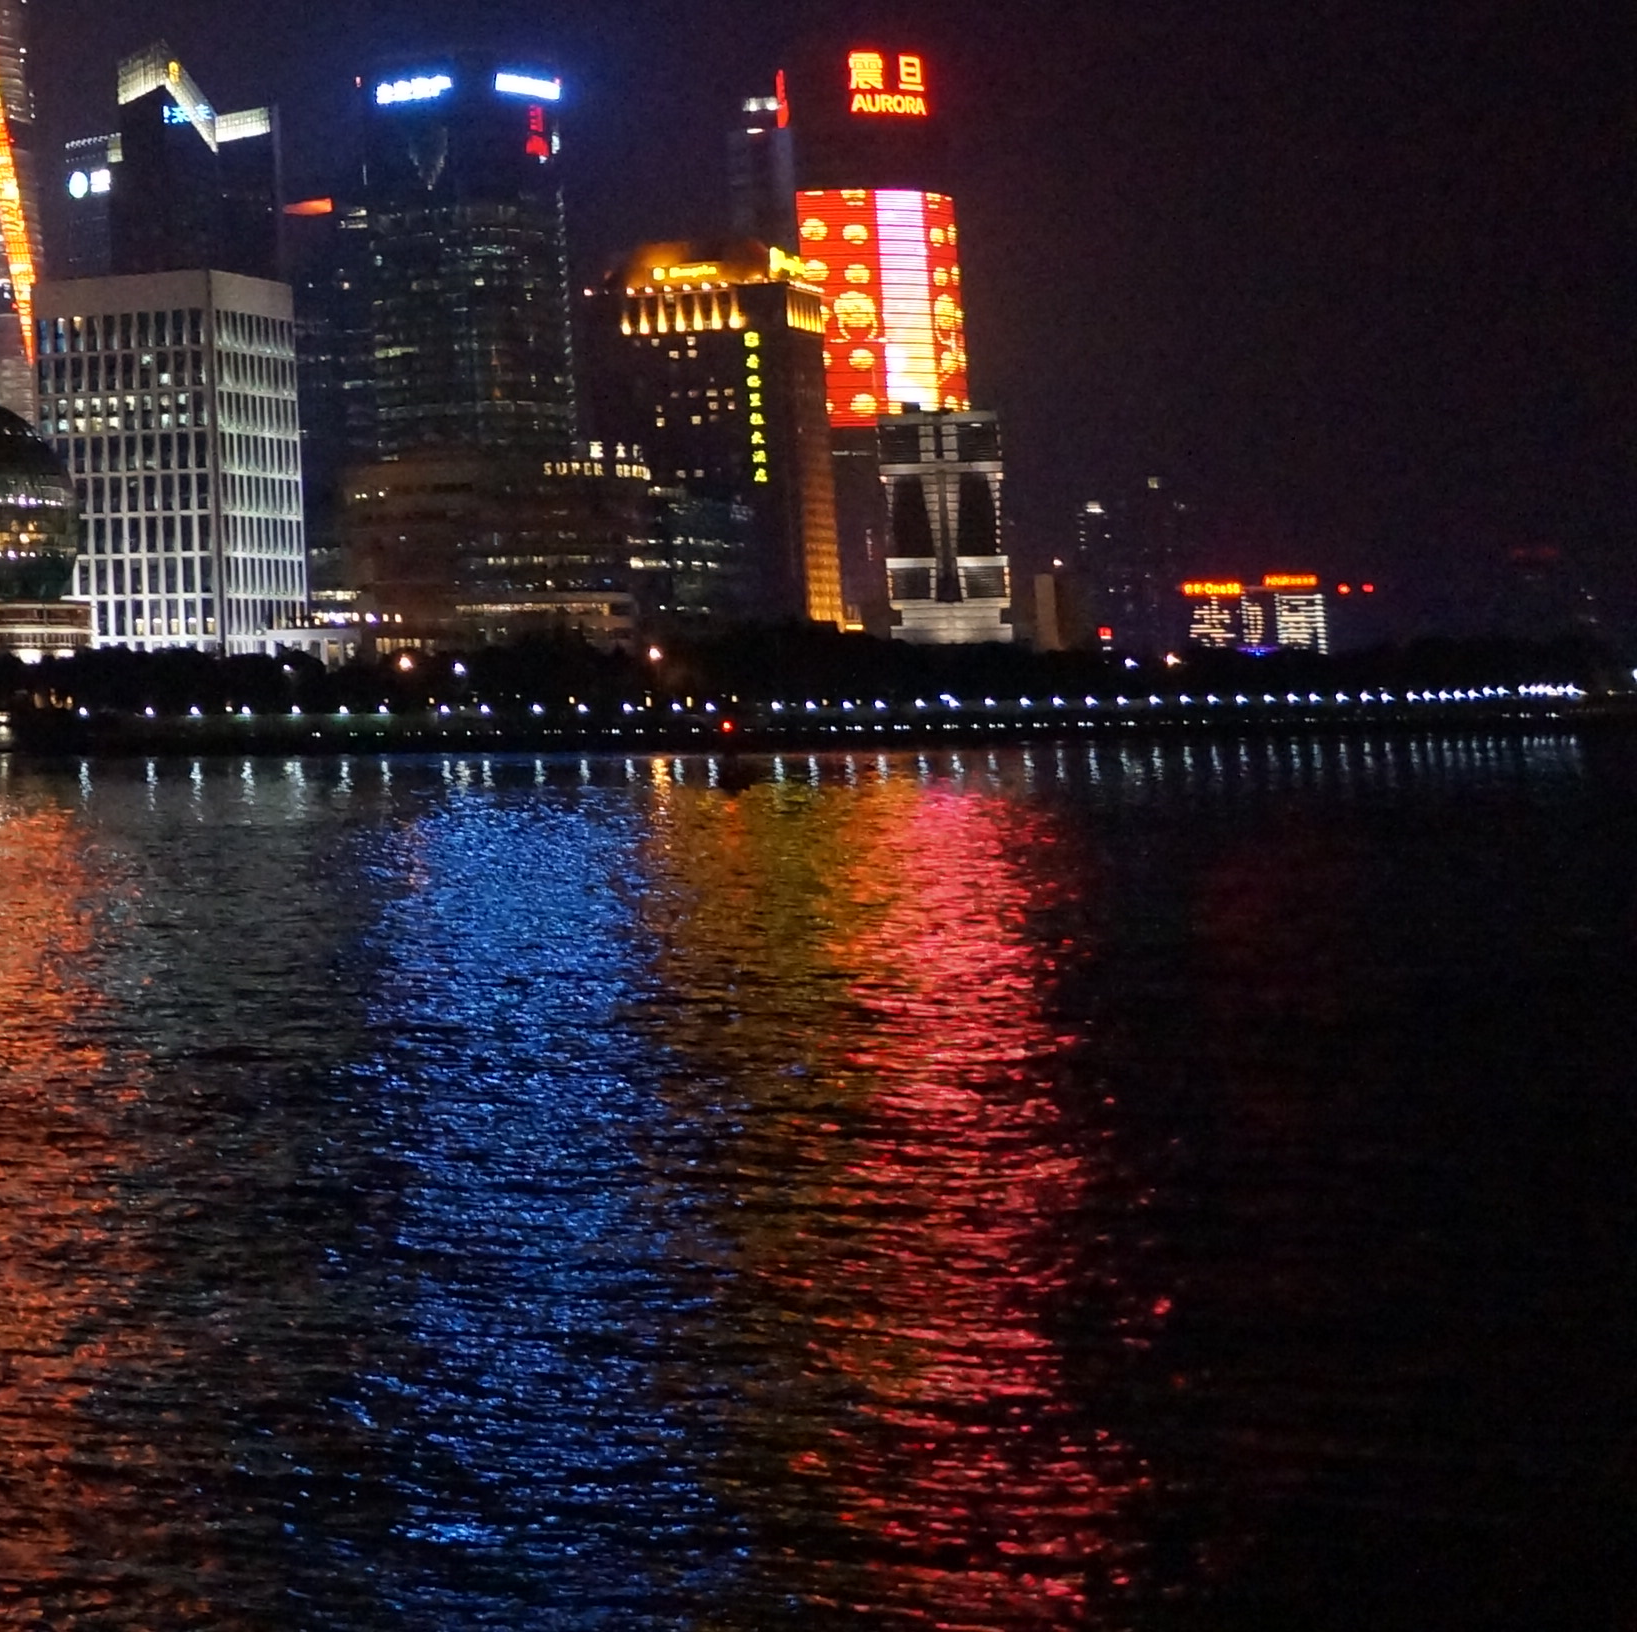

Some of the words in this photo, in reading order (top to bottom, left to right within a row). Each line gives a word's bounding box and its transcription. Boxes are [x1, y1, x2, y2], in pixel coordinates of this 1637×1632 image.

[848, 51, 925, 91] 震旦
[851, 93, 928, 116] AURORA
[543, 461, 604, 477] SUPER
